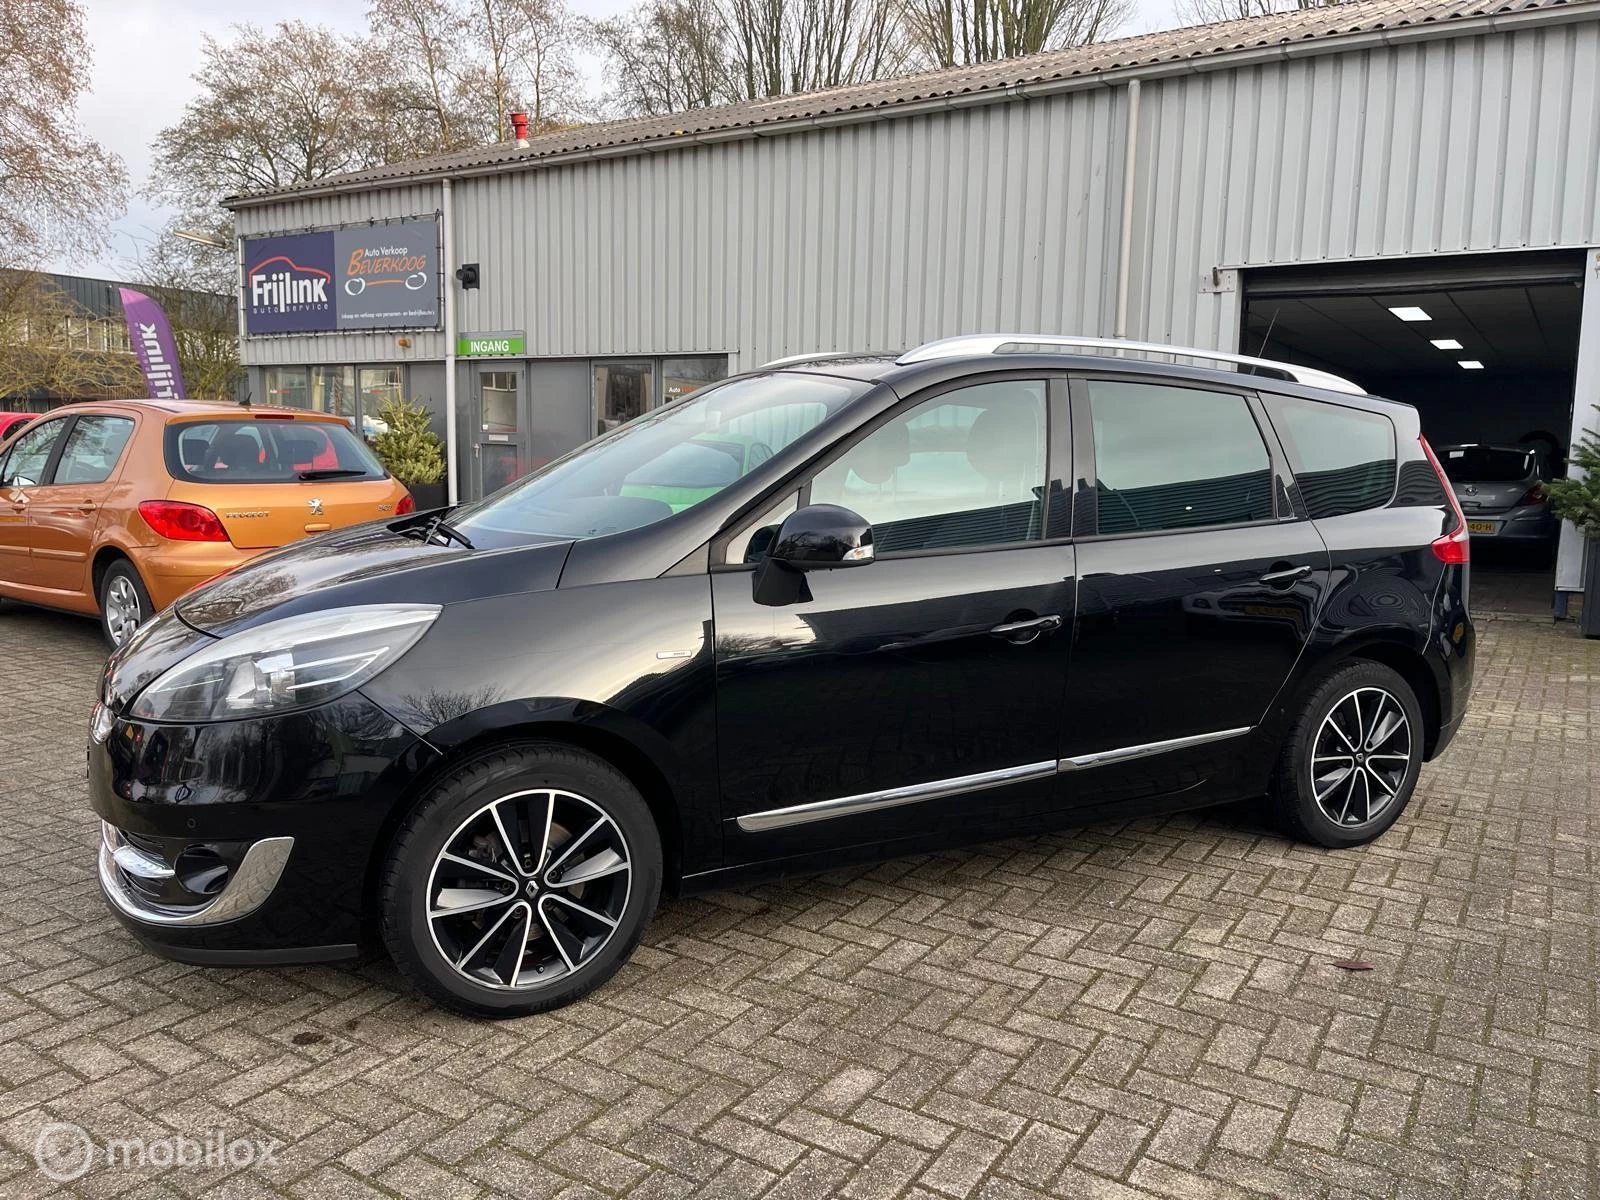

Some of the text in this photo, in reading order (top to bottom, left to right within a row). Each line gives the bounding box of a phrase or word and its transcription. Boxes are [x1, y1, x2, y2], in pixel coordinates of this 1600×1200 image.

[364, 245, 408, 257] Auto Verkoop
[346, 248, 427, 276] BEVERKOOG
[252, 272, 328, 313] Frijlink
[470, 340, 509, 353] INGANG
[225, 510, 270, 519] PEUGEOT
